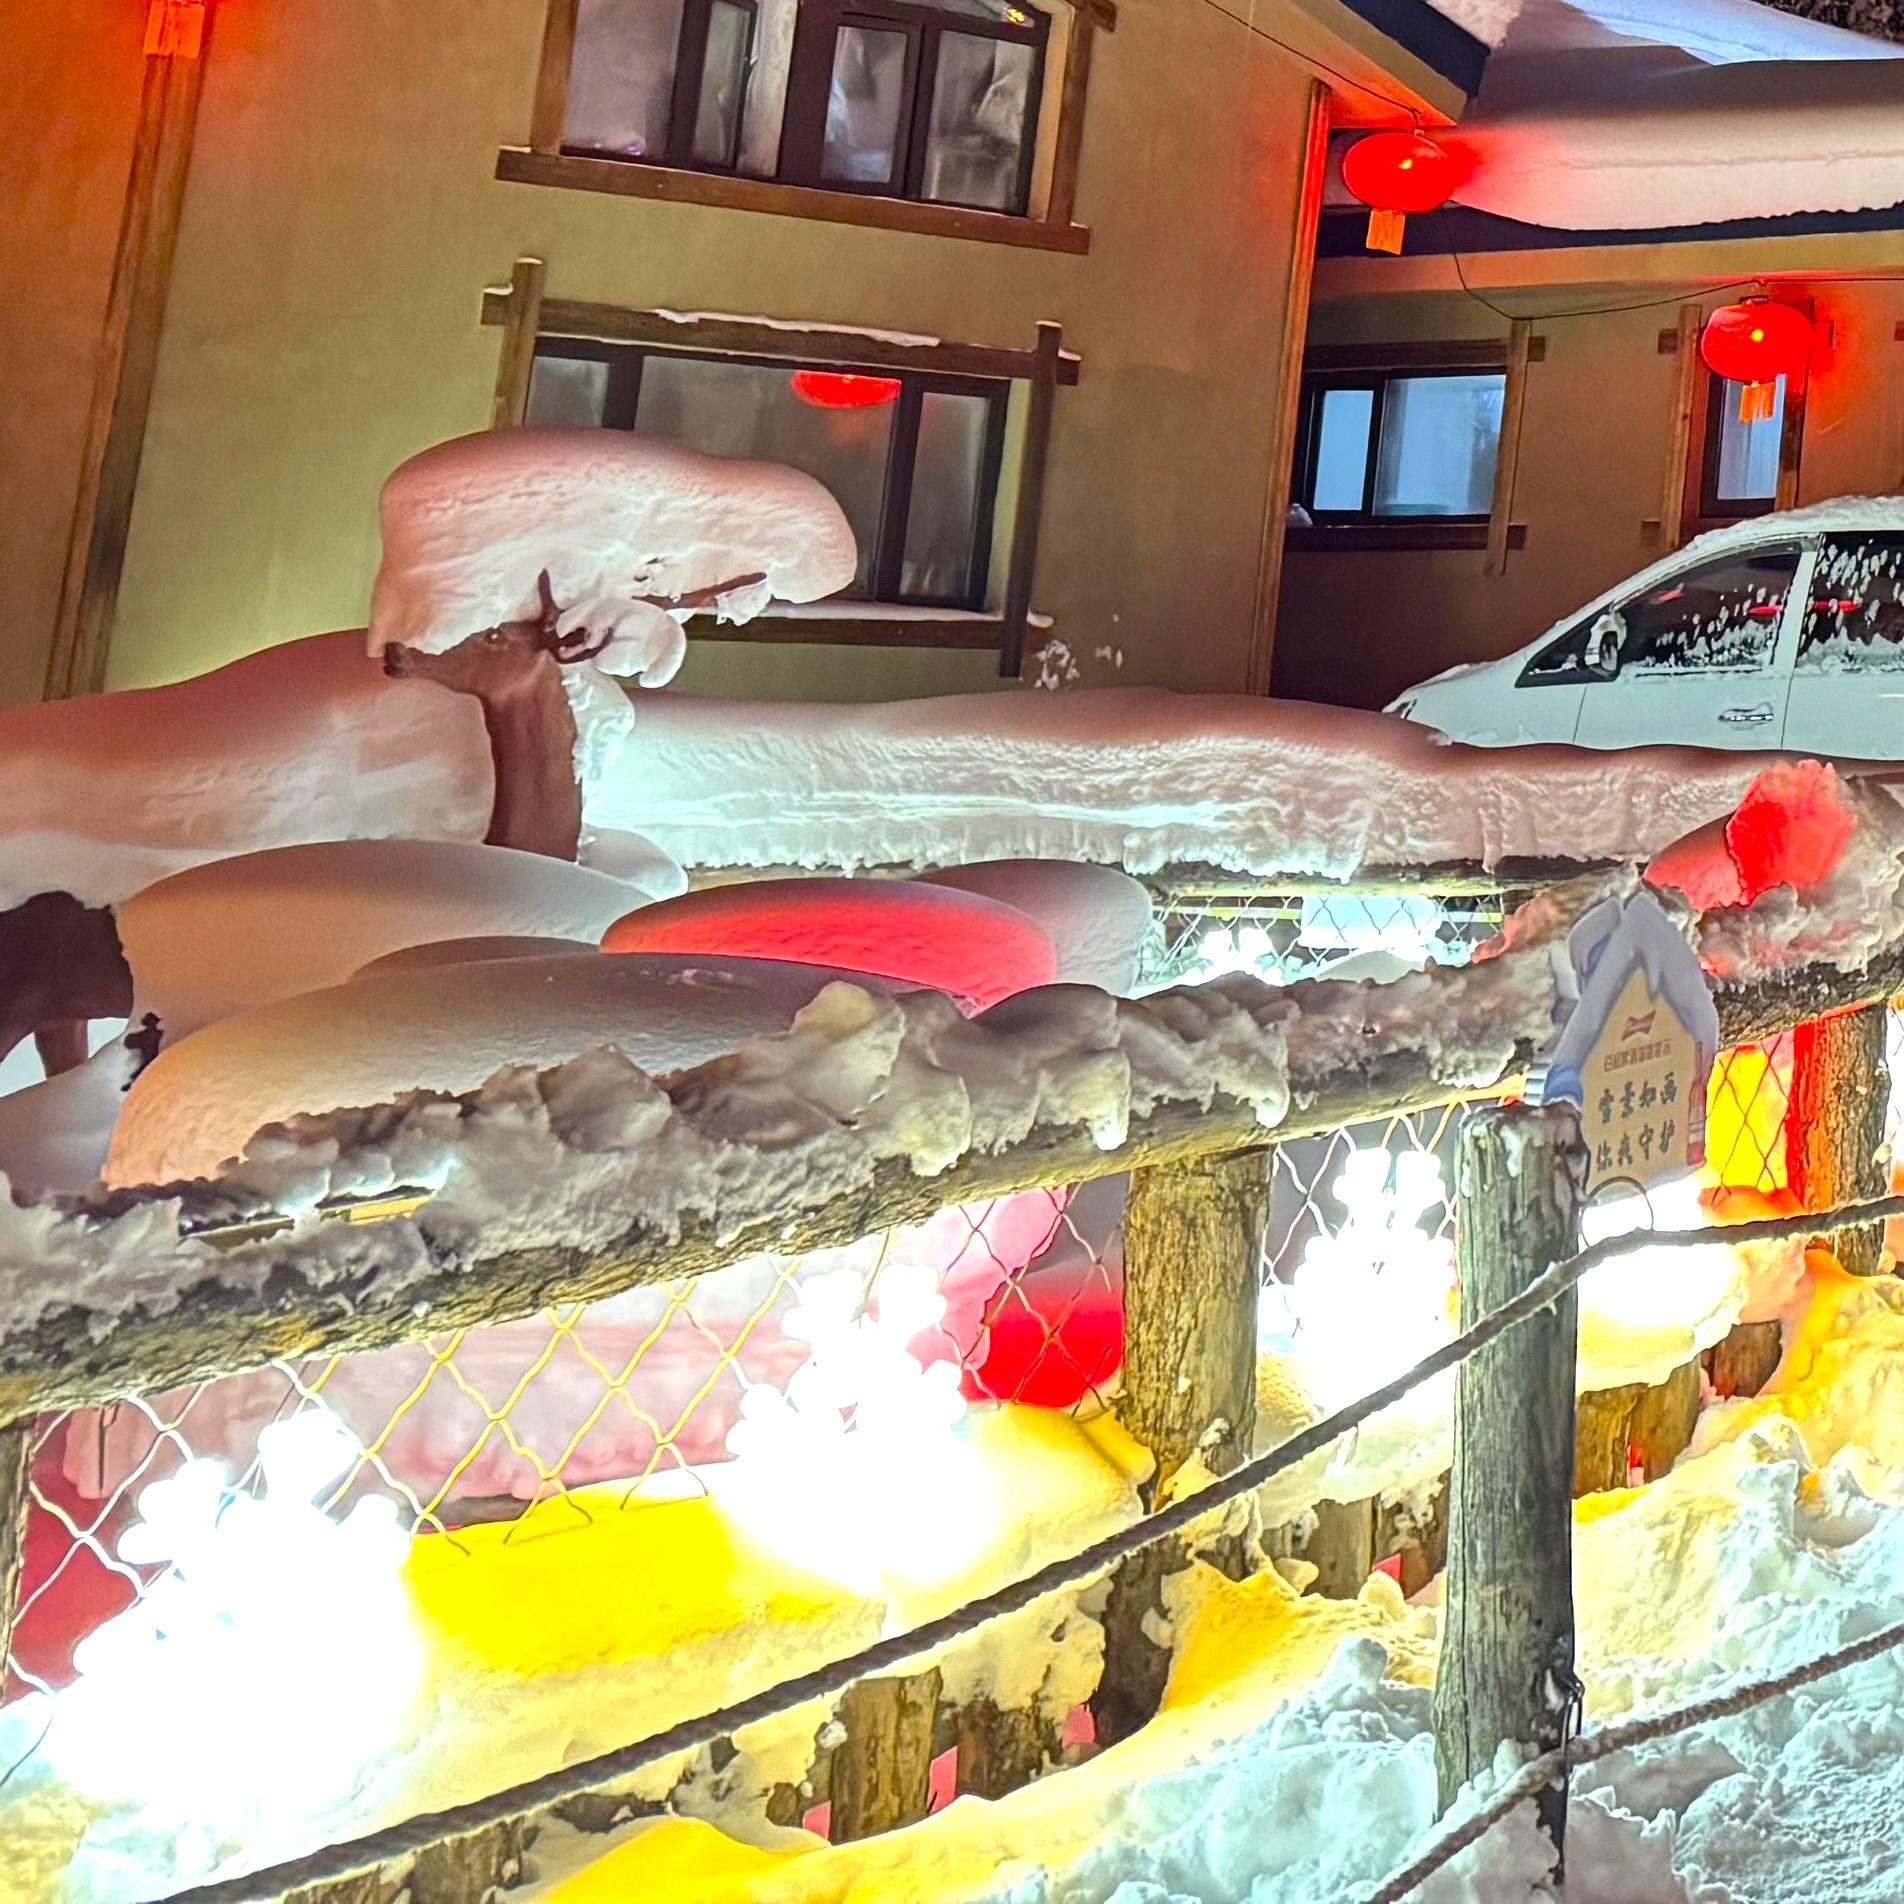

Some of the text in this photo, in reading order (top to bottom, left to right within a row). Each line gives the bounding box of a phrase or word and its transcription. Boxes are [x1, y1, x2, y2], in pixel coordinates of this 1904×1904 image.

[1598, 1071, 1677, 1124] 雪景如画
[1596, 1119, 1676, 1173] 你我守护
